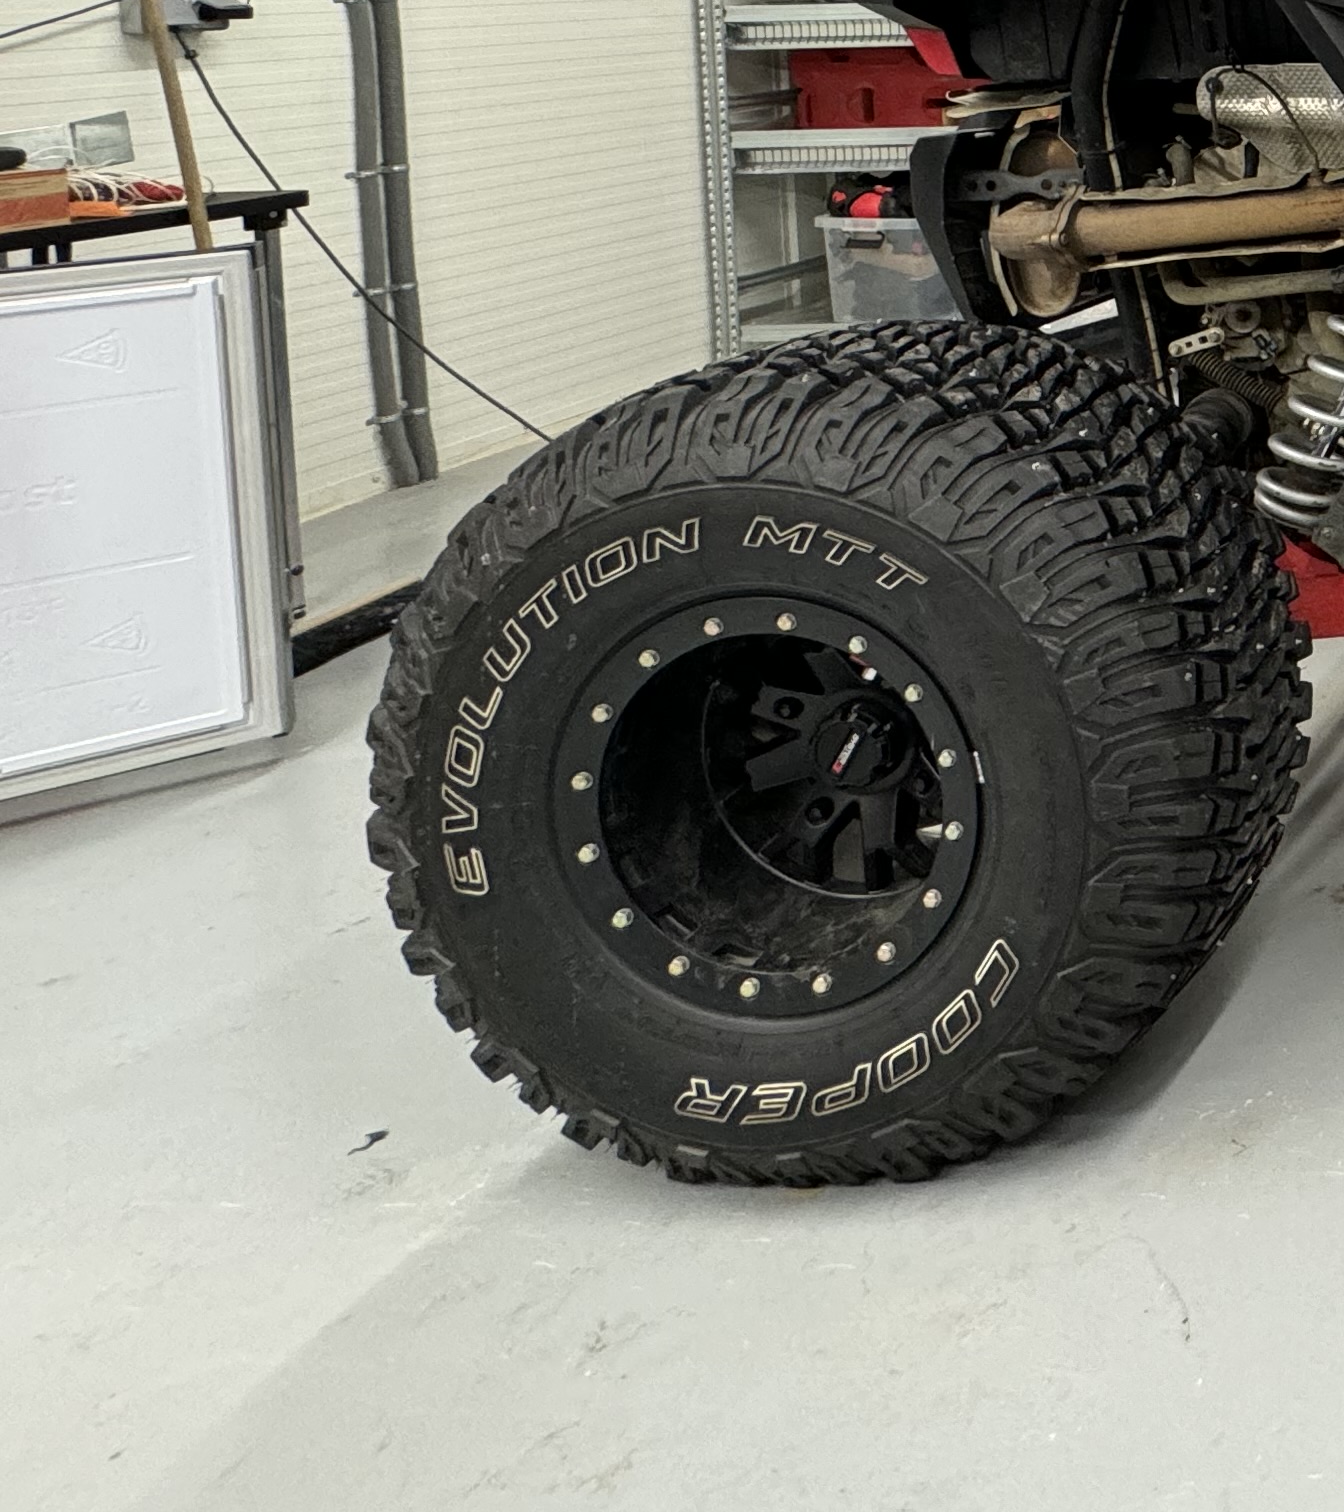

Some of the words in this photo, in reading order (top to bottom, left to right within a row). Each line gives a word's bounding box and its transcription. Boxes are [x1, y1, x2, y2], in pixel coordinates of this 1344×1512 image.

[440, 515, 701, 896] EVOLUTION
[741, 514, 930, 592] MTT
[674, 937, 1021, 1127] COOPER
